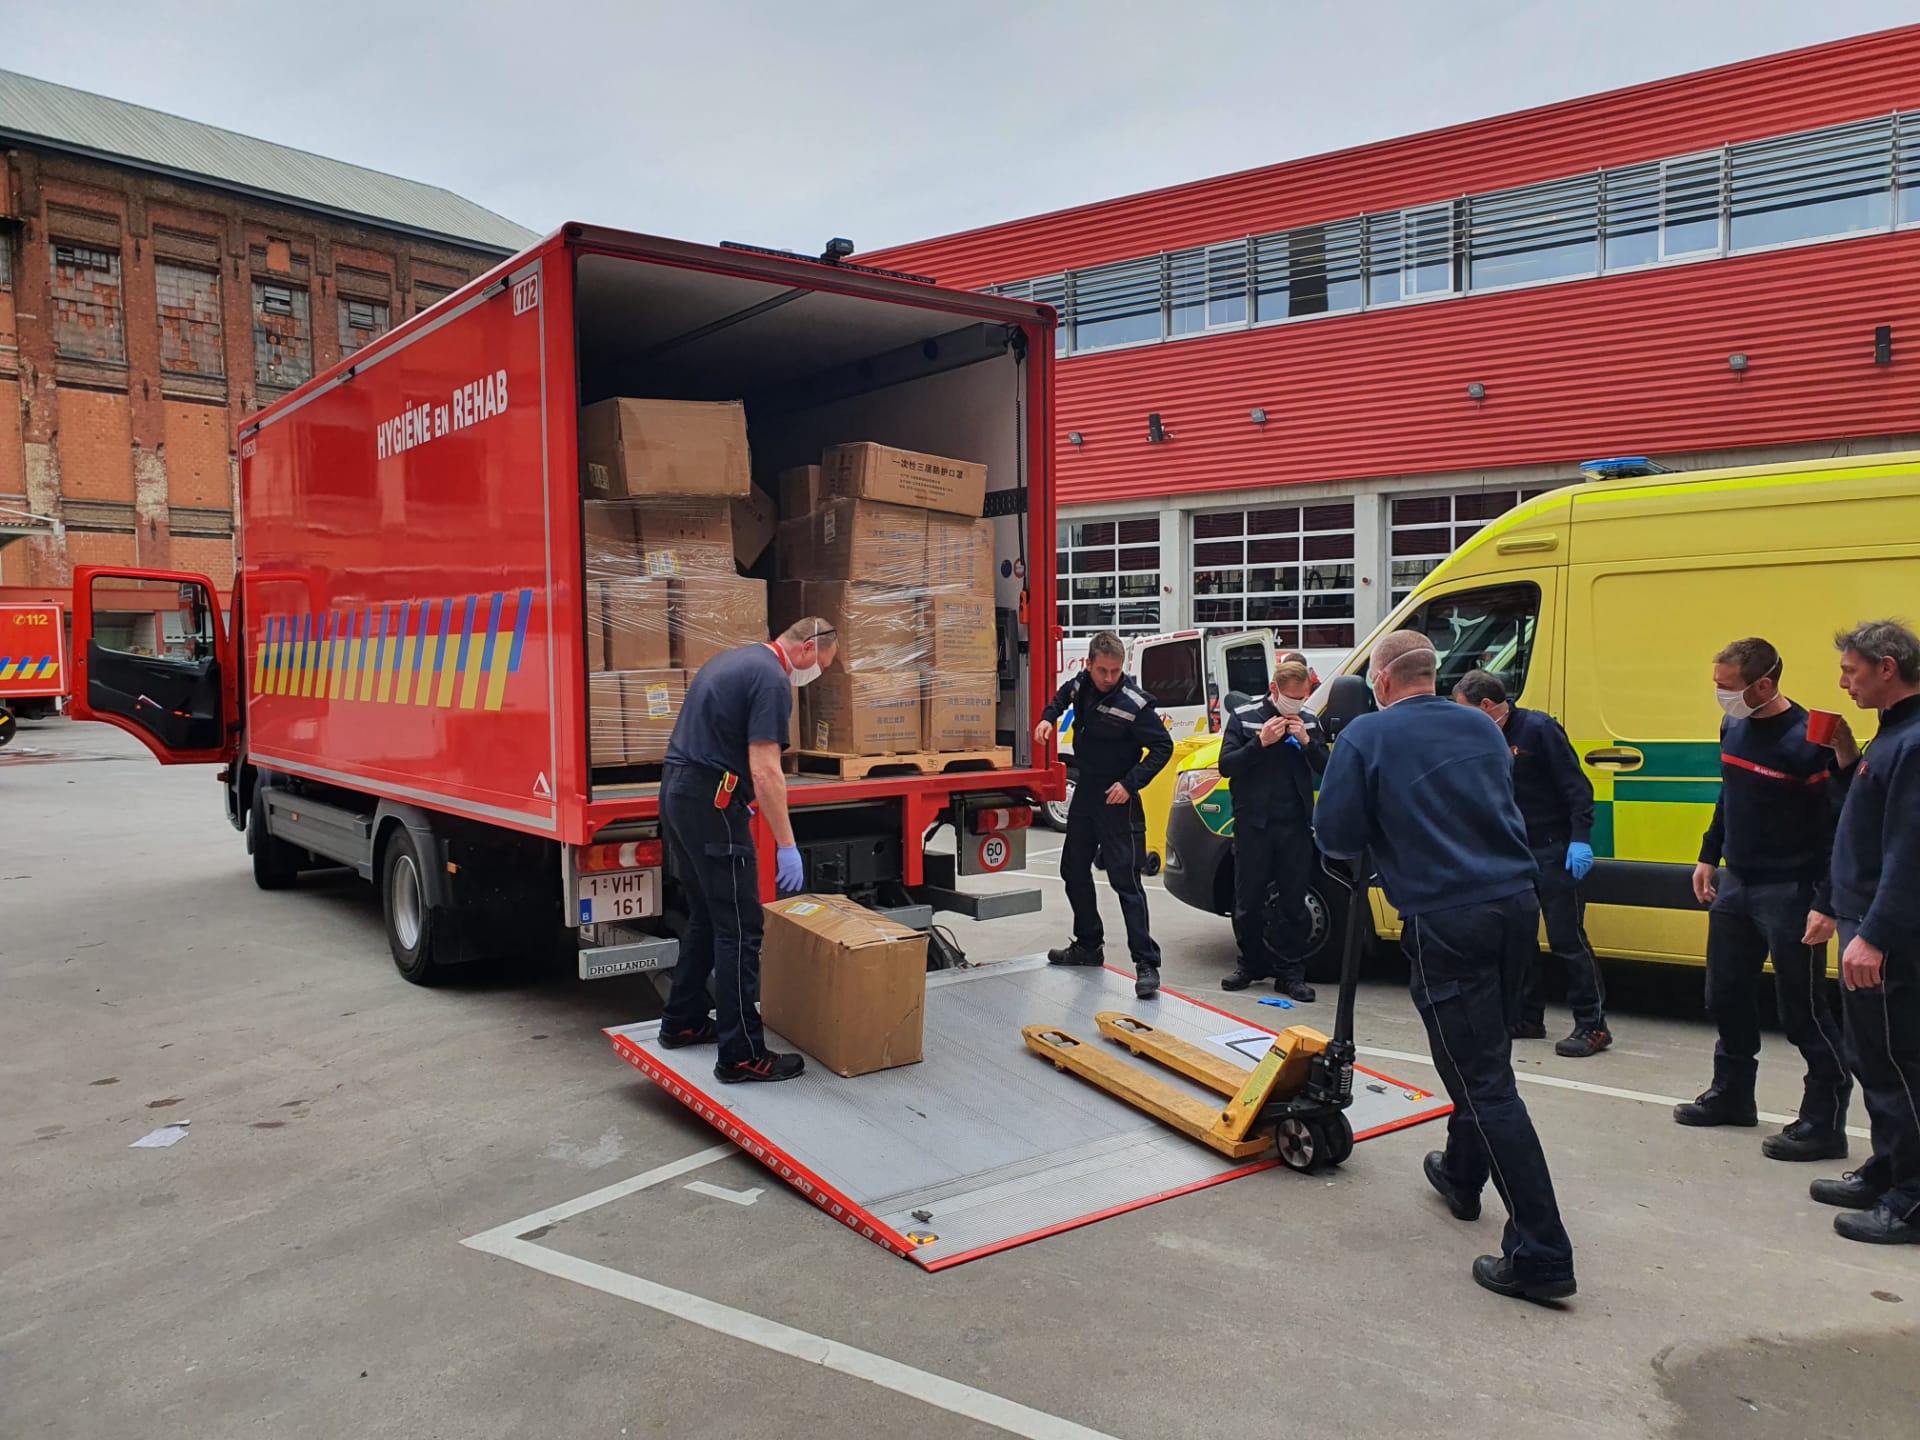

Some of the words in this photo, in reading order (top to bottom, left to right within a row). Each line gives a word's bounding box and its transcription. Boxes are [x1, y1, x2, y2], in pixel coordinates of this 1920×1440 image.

[520, 278, 537, 311] 112
[377, 400, 431, 461] HYGIËNE
[434, 403, 449, 438] EN
[453, 369, 509, 432] REHAB
[26, 614, 48, 625] 112
[987, 842, 1002, 856] 60
[613, 897, 643, 916] 161
[590, 959, 657, 975] DHOLLANDIA
